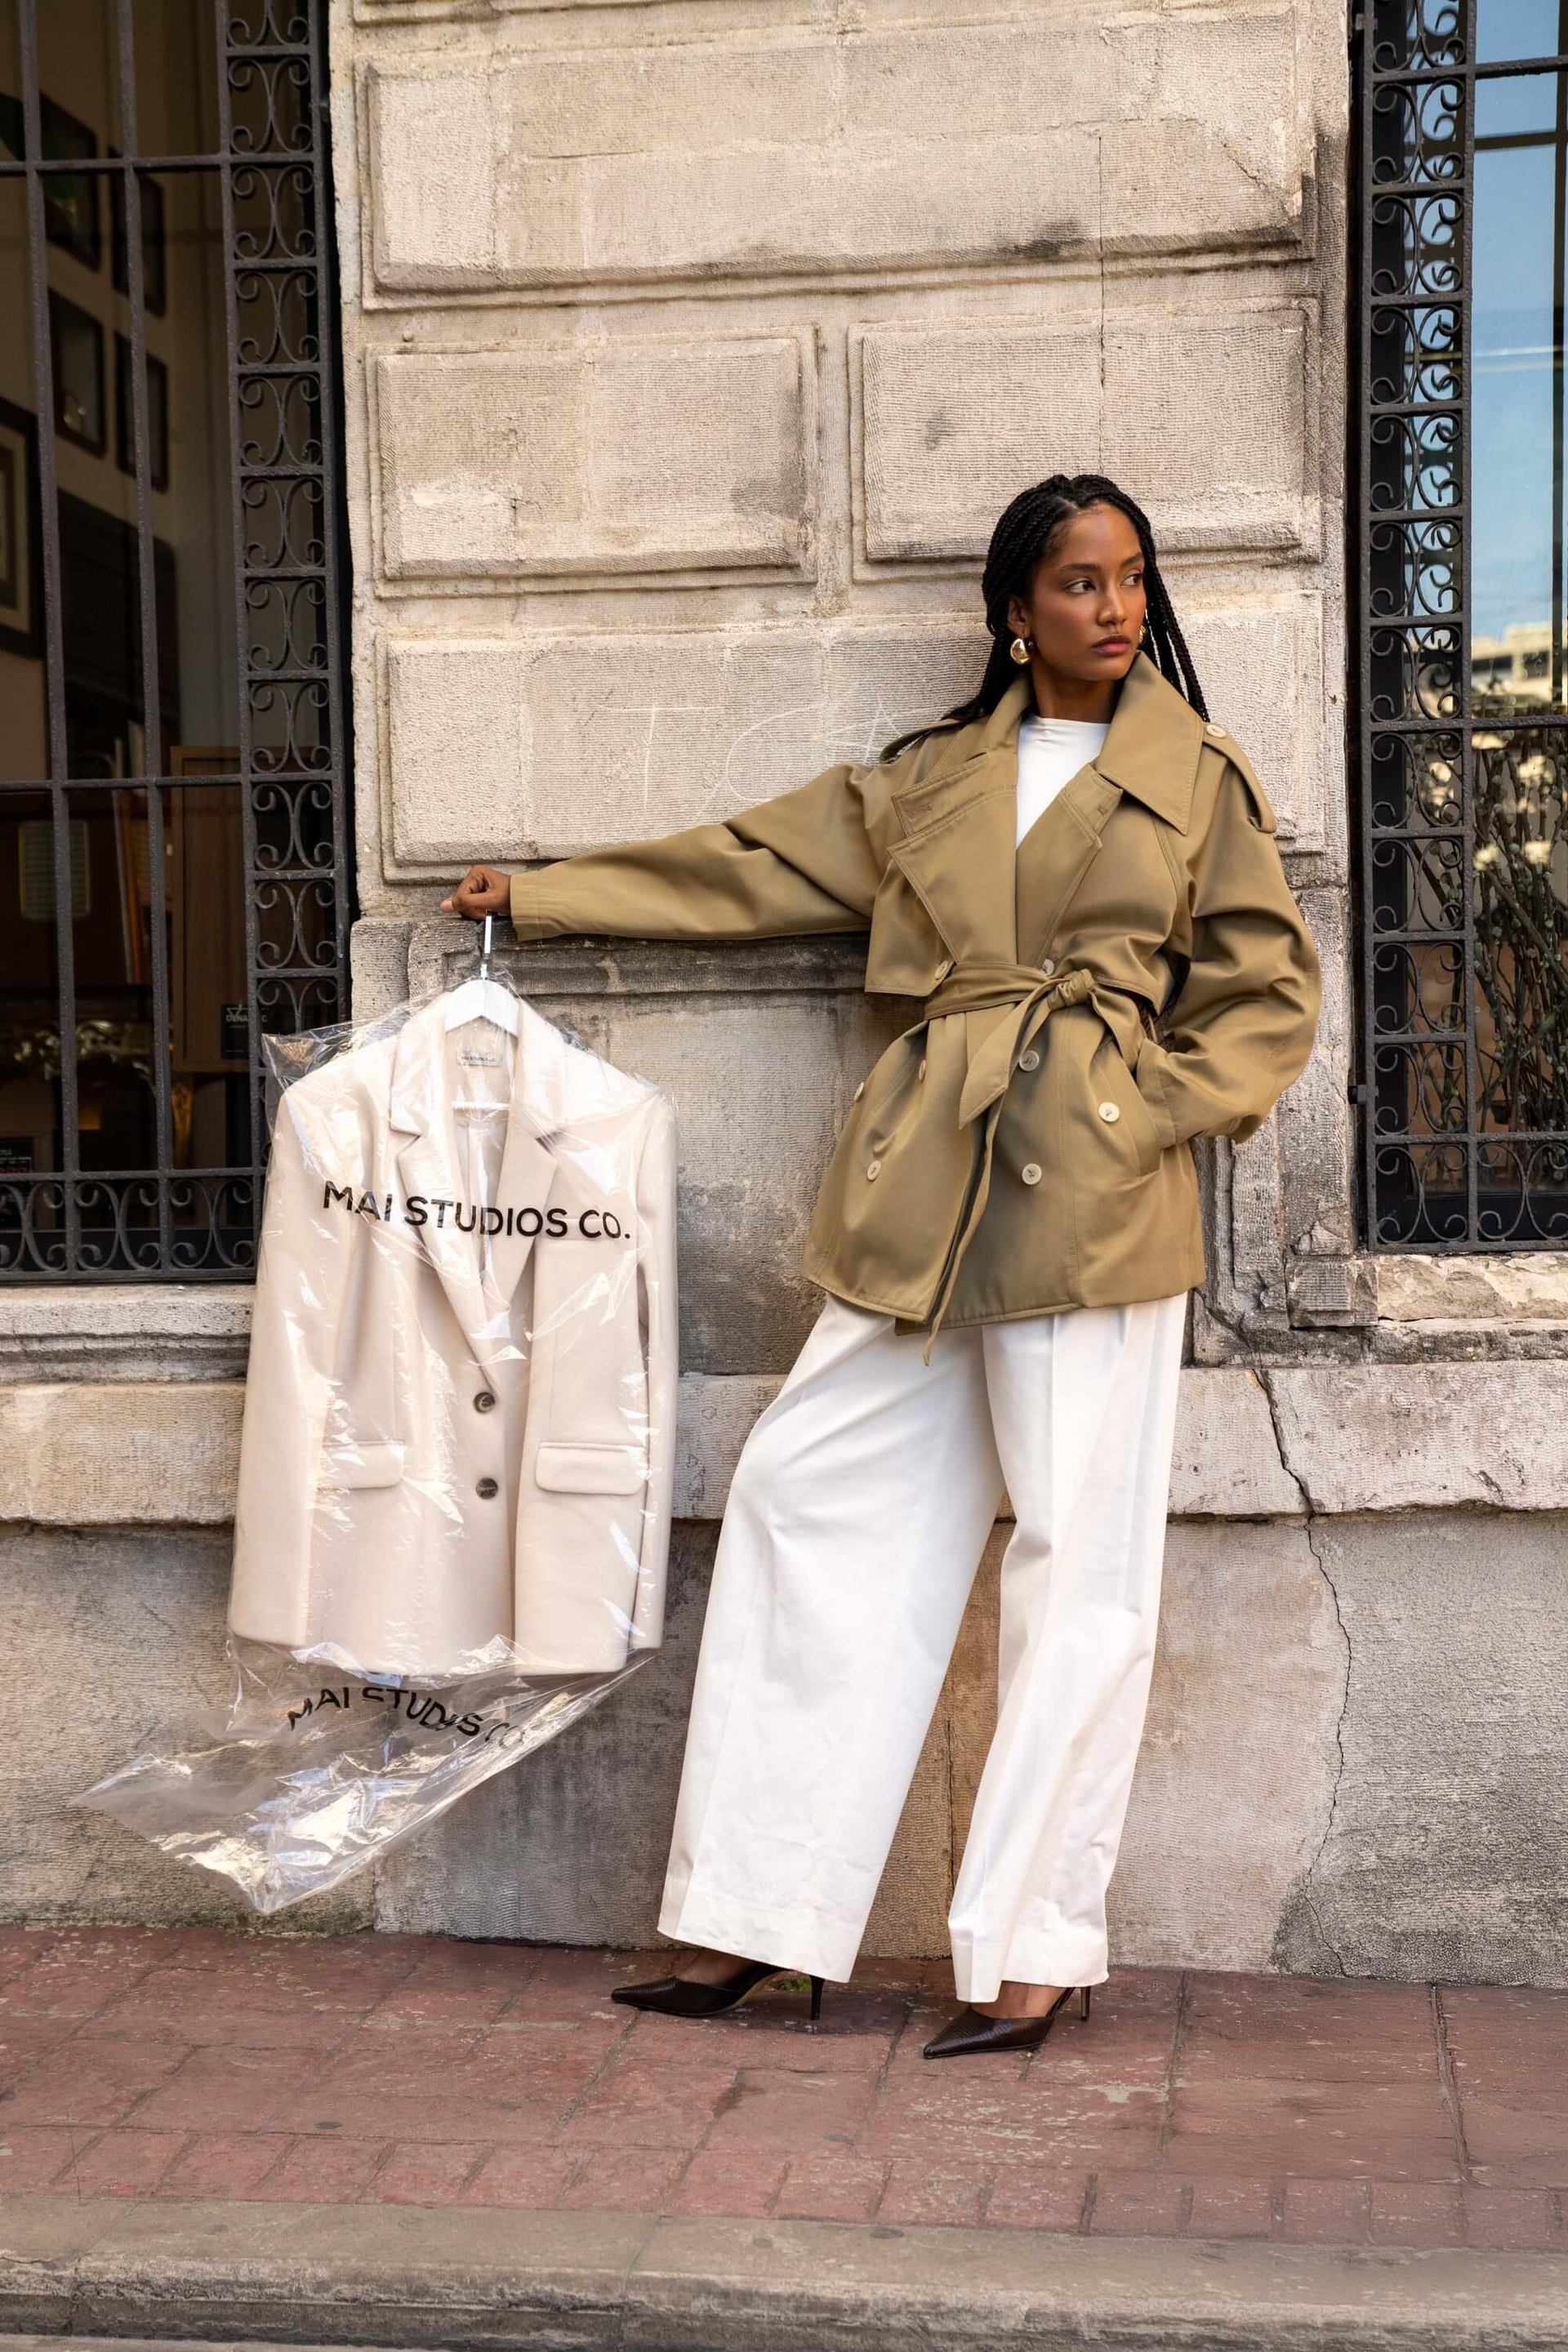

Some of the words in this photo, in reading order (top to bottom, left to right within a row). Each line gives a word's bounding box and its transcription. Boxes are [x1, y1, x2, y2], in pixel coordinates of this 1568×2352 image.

[323, 1180, 394, 1223] MAI
[403, 1195, 568, 1239] STUDIOS
[578, 1209, 631, 1240] CO.
[287, 1686, 350, 1731] MAI
